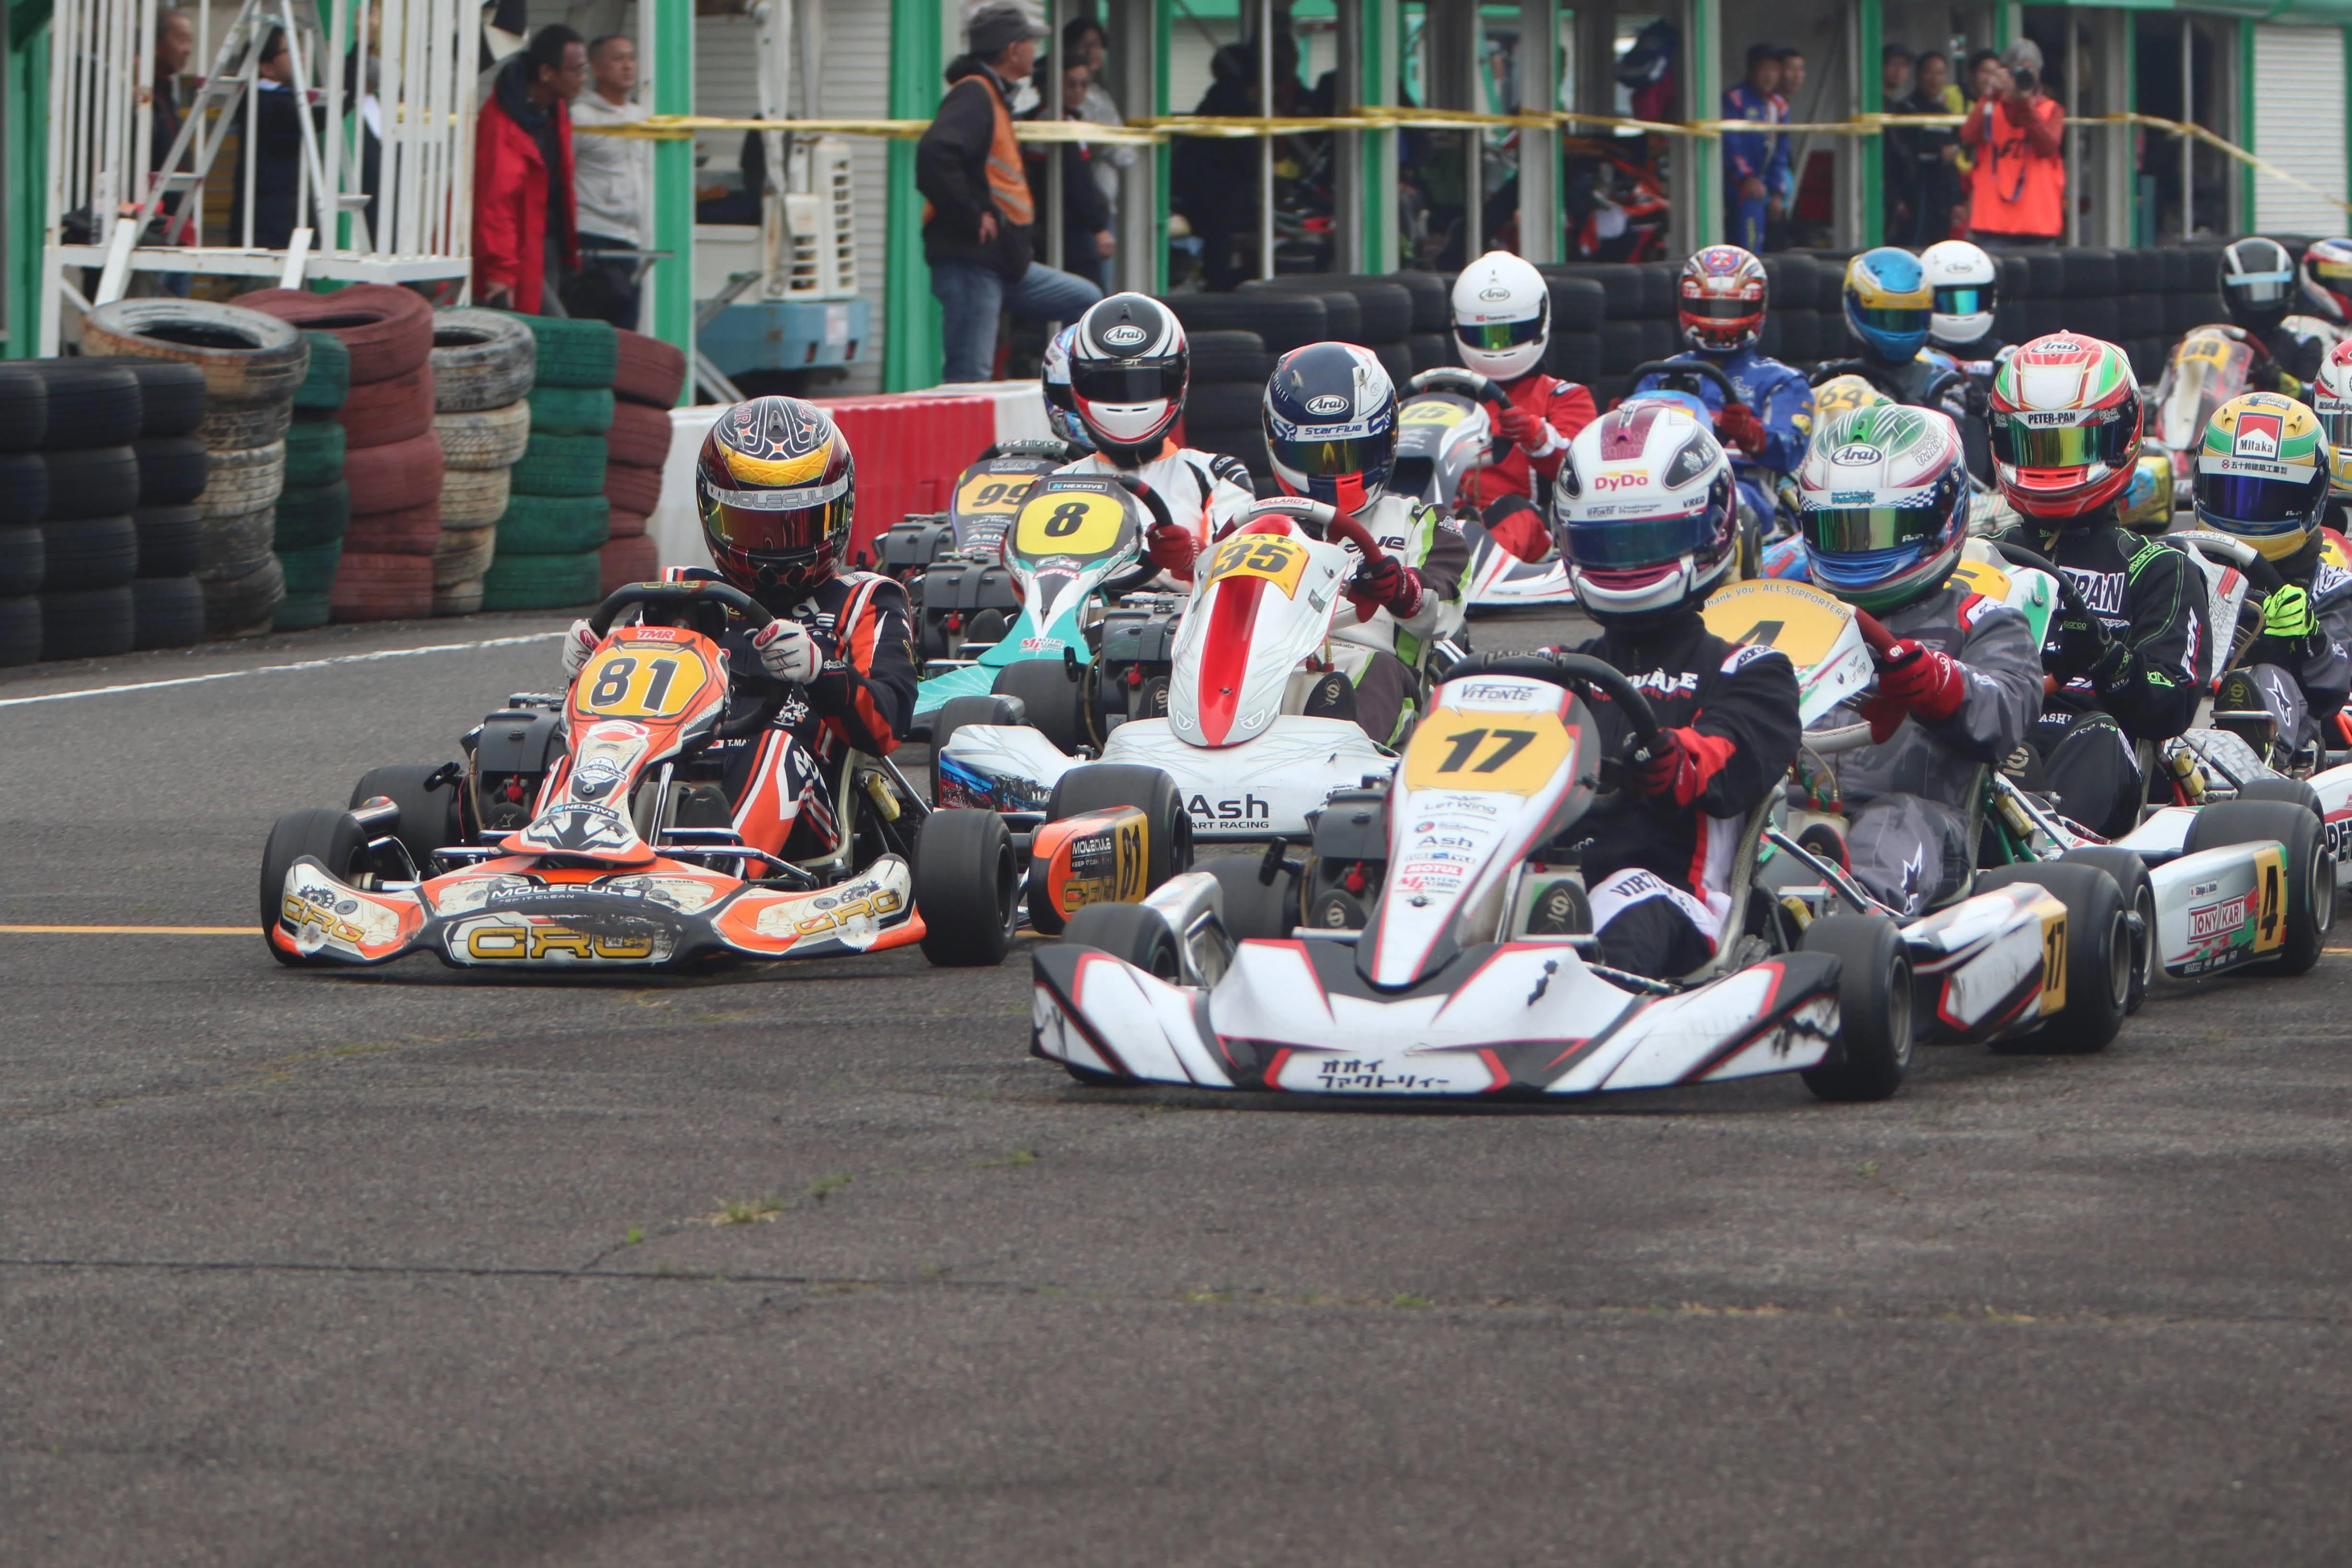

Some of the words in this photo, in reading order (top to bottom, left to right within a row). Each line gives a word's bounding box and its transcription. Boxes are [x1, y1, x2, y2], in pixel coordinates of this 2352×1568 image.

[1110, 328, 1140, 340] Arai
[1311, 398, 1342, 410] Arai
[2028, 412, 2076, 424] PETER-PAN
[1835, 446, 1877, 462] Arai
[2239, 439, 2272, 453] Mitaka
[1594, 474, 1649, 491] DyDo
[722, 485, 835, 509] MOLECULE
[1044, 503, 1090, 537] 8
[1211, 543, 1290, 578] 35
[2128, 544, 2164, 574] sparco
[1735, 586, 1755, 596] you
[1762, 583, 1782, 592] ALL
[1785, 585, 1847, 620] SUPPORTERS
[637, 630, 675, 640] TMR
[589, 656, 679, 714] 81
[727, 739, 751, 748] T.MA
[1437, 728, 1539, 774] 17
[565, 802, 616, 818] NEXXIVE
[1187, 793, 1270, 819] Ash
[1072, 838, 1111, 856] MOLECULE
[1418, 835, 1473, 848] Ash
[1119, 825, 1141, 901] 81
[1407, 865, 1459, 874] MOTUL
[491, 884, 641, 899] MOLECULE
[535, 894, 575, 902] CLEAN
[793, 888, 903, 936] CRG
[2260, 865, 2278, 941] 4
[283, 896, 365, 943] CRG
[2194, 912, 2218, 935] TONY
[2221, 905, 2242, 927] KART
[468, 925, 654, 960] CRG
[2046, 919, 2066, 993] 17
[1322, 1058, 1384, 1073] オオイ
[1317, 1075, 1449, 1088] ファクトリィー
